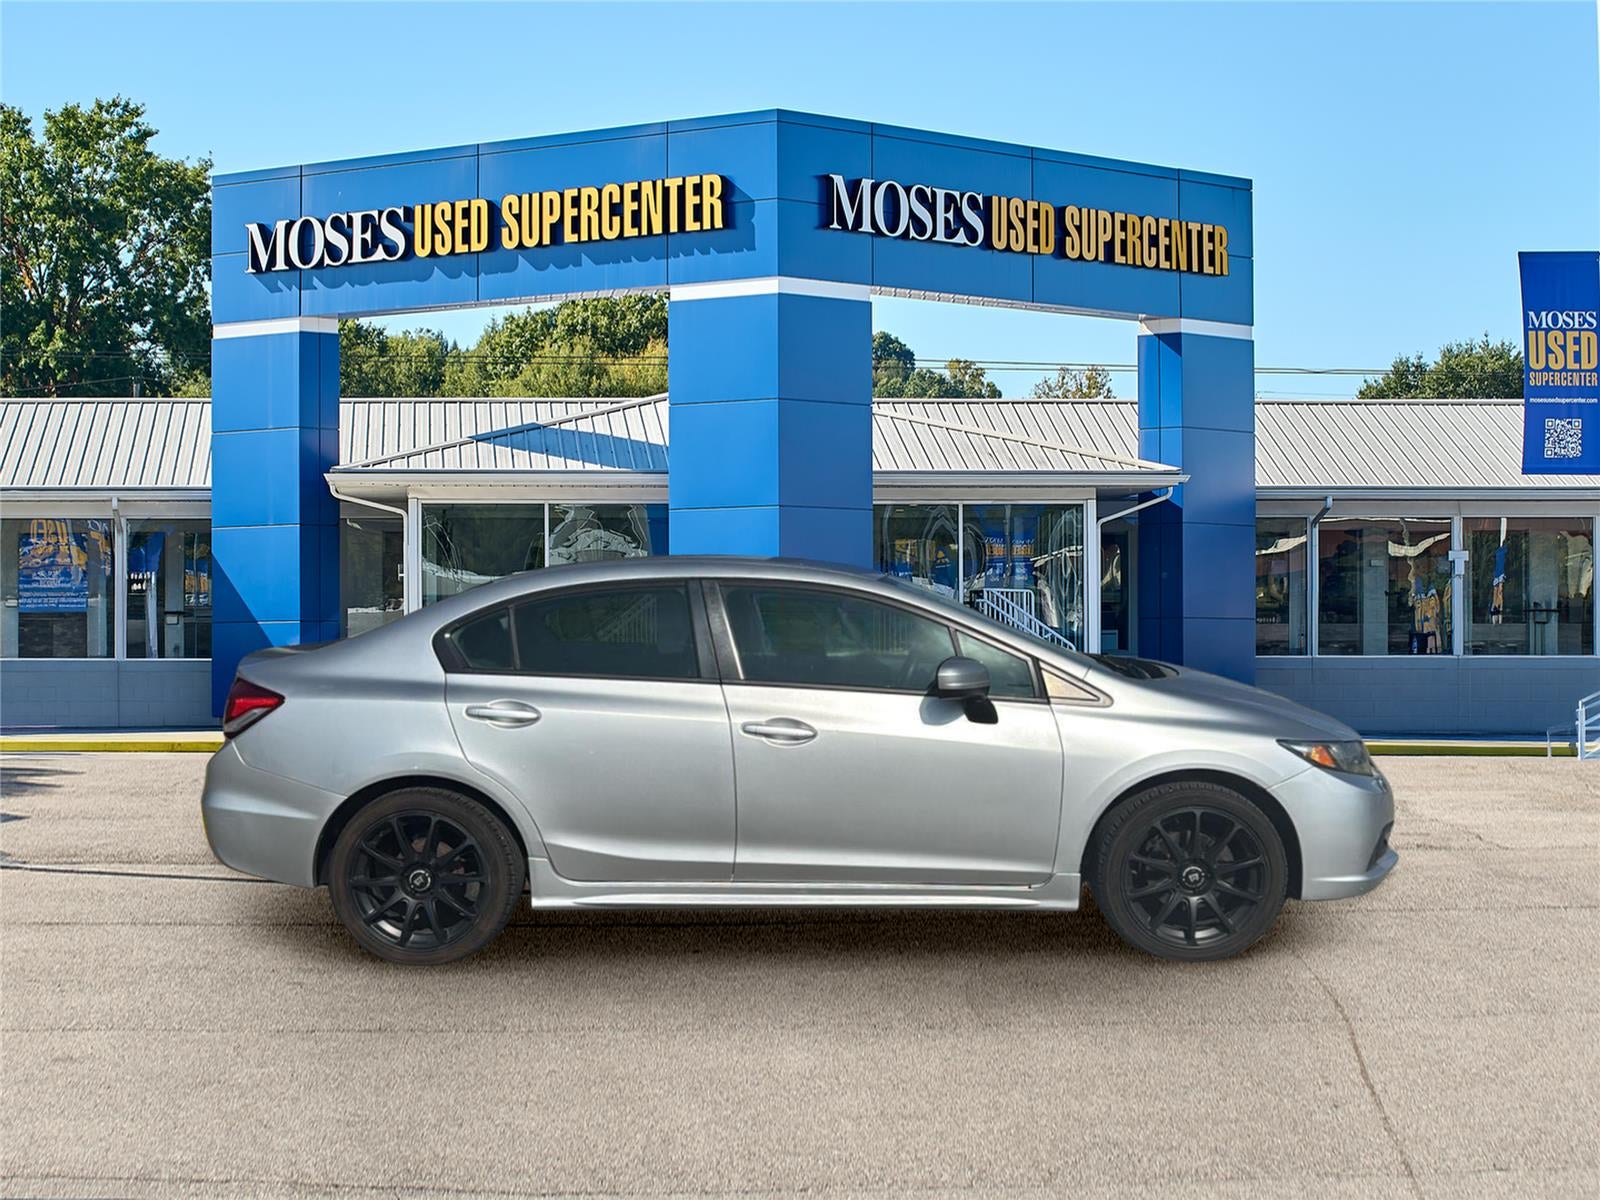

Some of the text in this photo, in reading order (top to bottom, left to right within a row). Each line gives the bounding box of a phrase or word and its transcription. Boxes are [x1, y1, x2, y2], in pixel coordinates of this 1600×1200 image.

[244, 173, 723, 274] MOSES USED SUPERCENTER
[829, 174, 1229, 276] MOSES USED SUPERCENTER
[1528, 311, 1597, 329] MOSES
[1528, 331, 1598, 370] USED
[1529, 372, 1598, 386] SUPERCENTER
